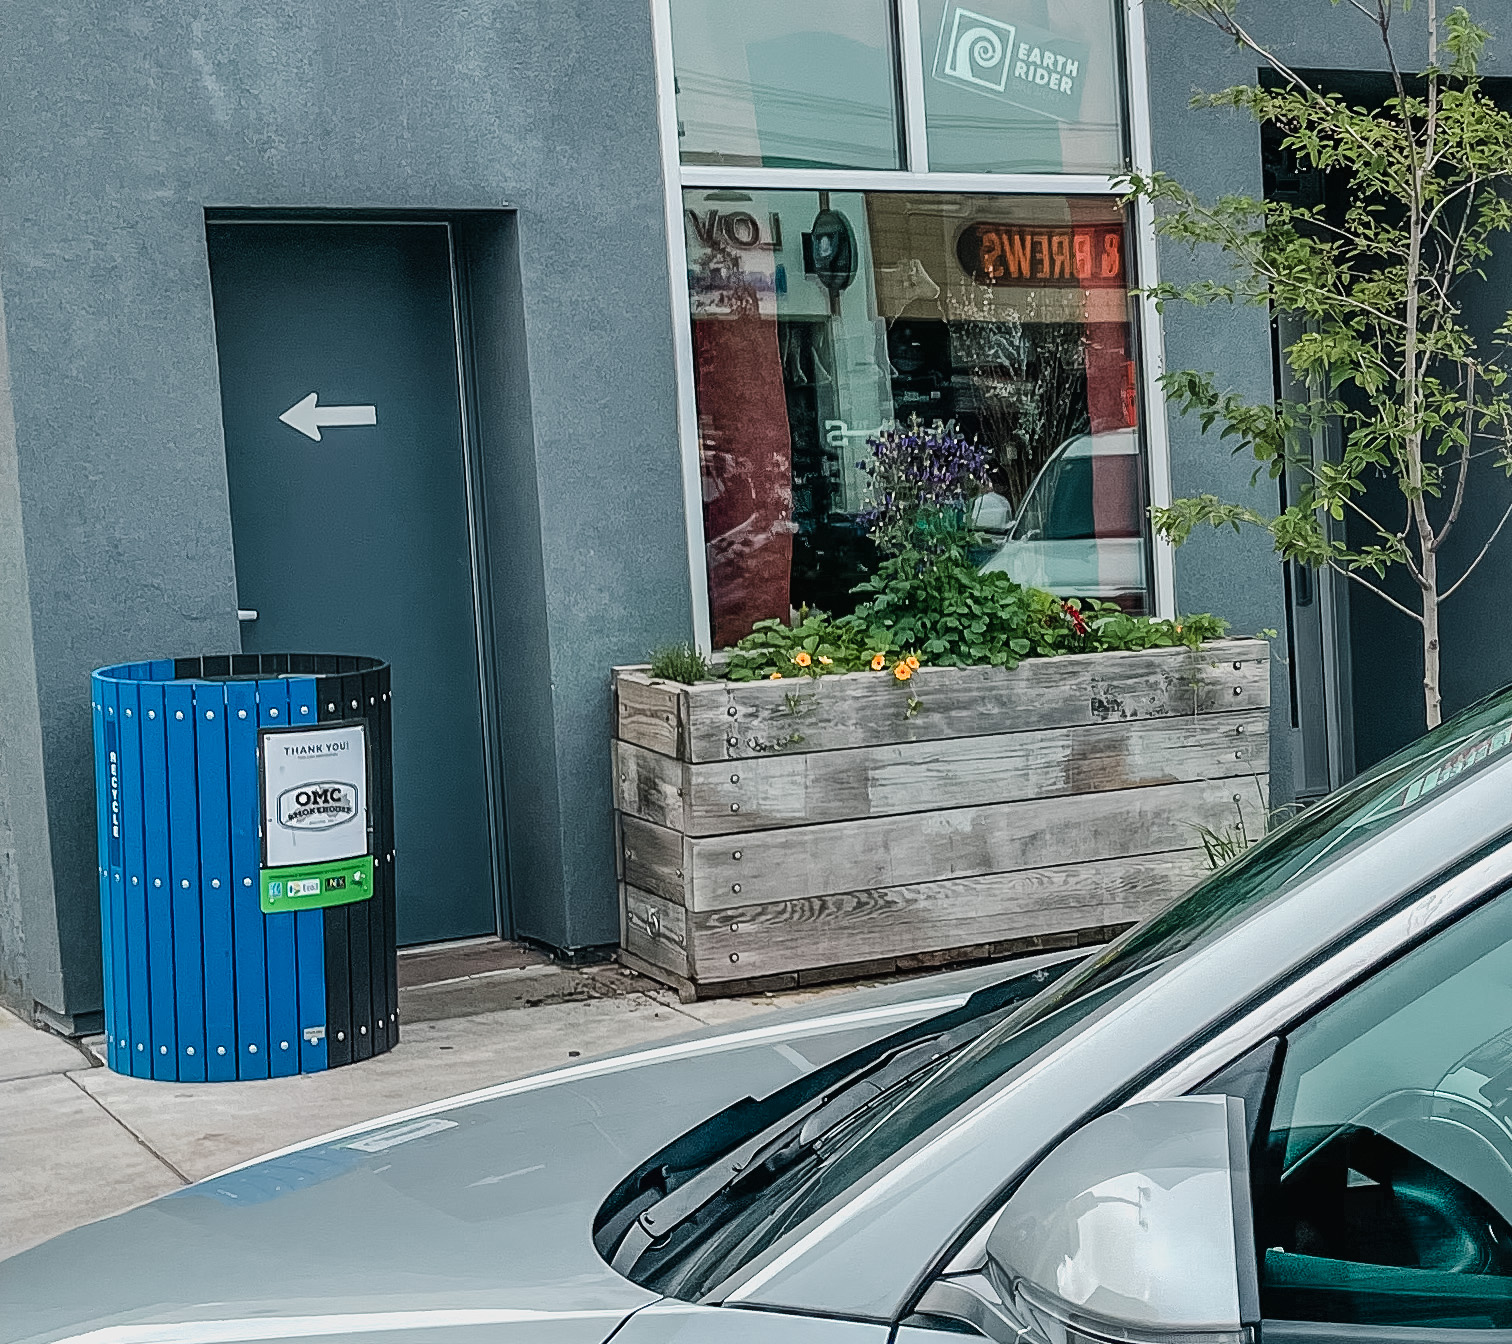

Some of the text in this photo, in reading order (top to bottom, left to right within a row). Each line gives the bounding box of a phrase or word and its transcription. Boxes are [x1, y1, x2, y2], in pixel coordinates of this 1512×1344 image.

[1017, 42, 1079, 77] EARTH
[1014, 60, 1073, 95] RIDER
[283, 743, 323, 757] THANK
[325, 740, 350, 754] YOU!
[109, 751, 120, 838] RECYCLE
[295, 787, 342, 807] OMC
